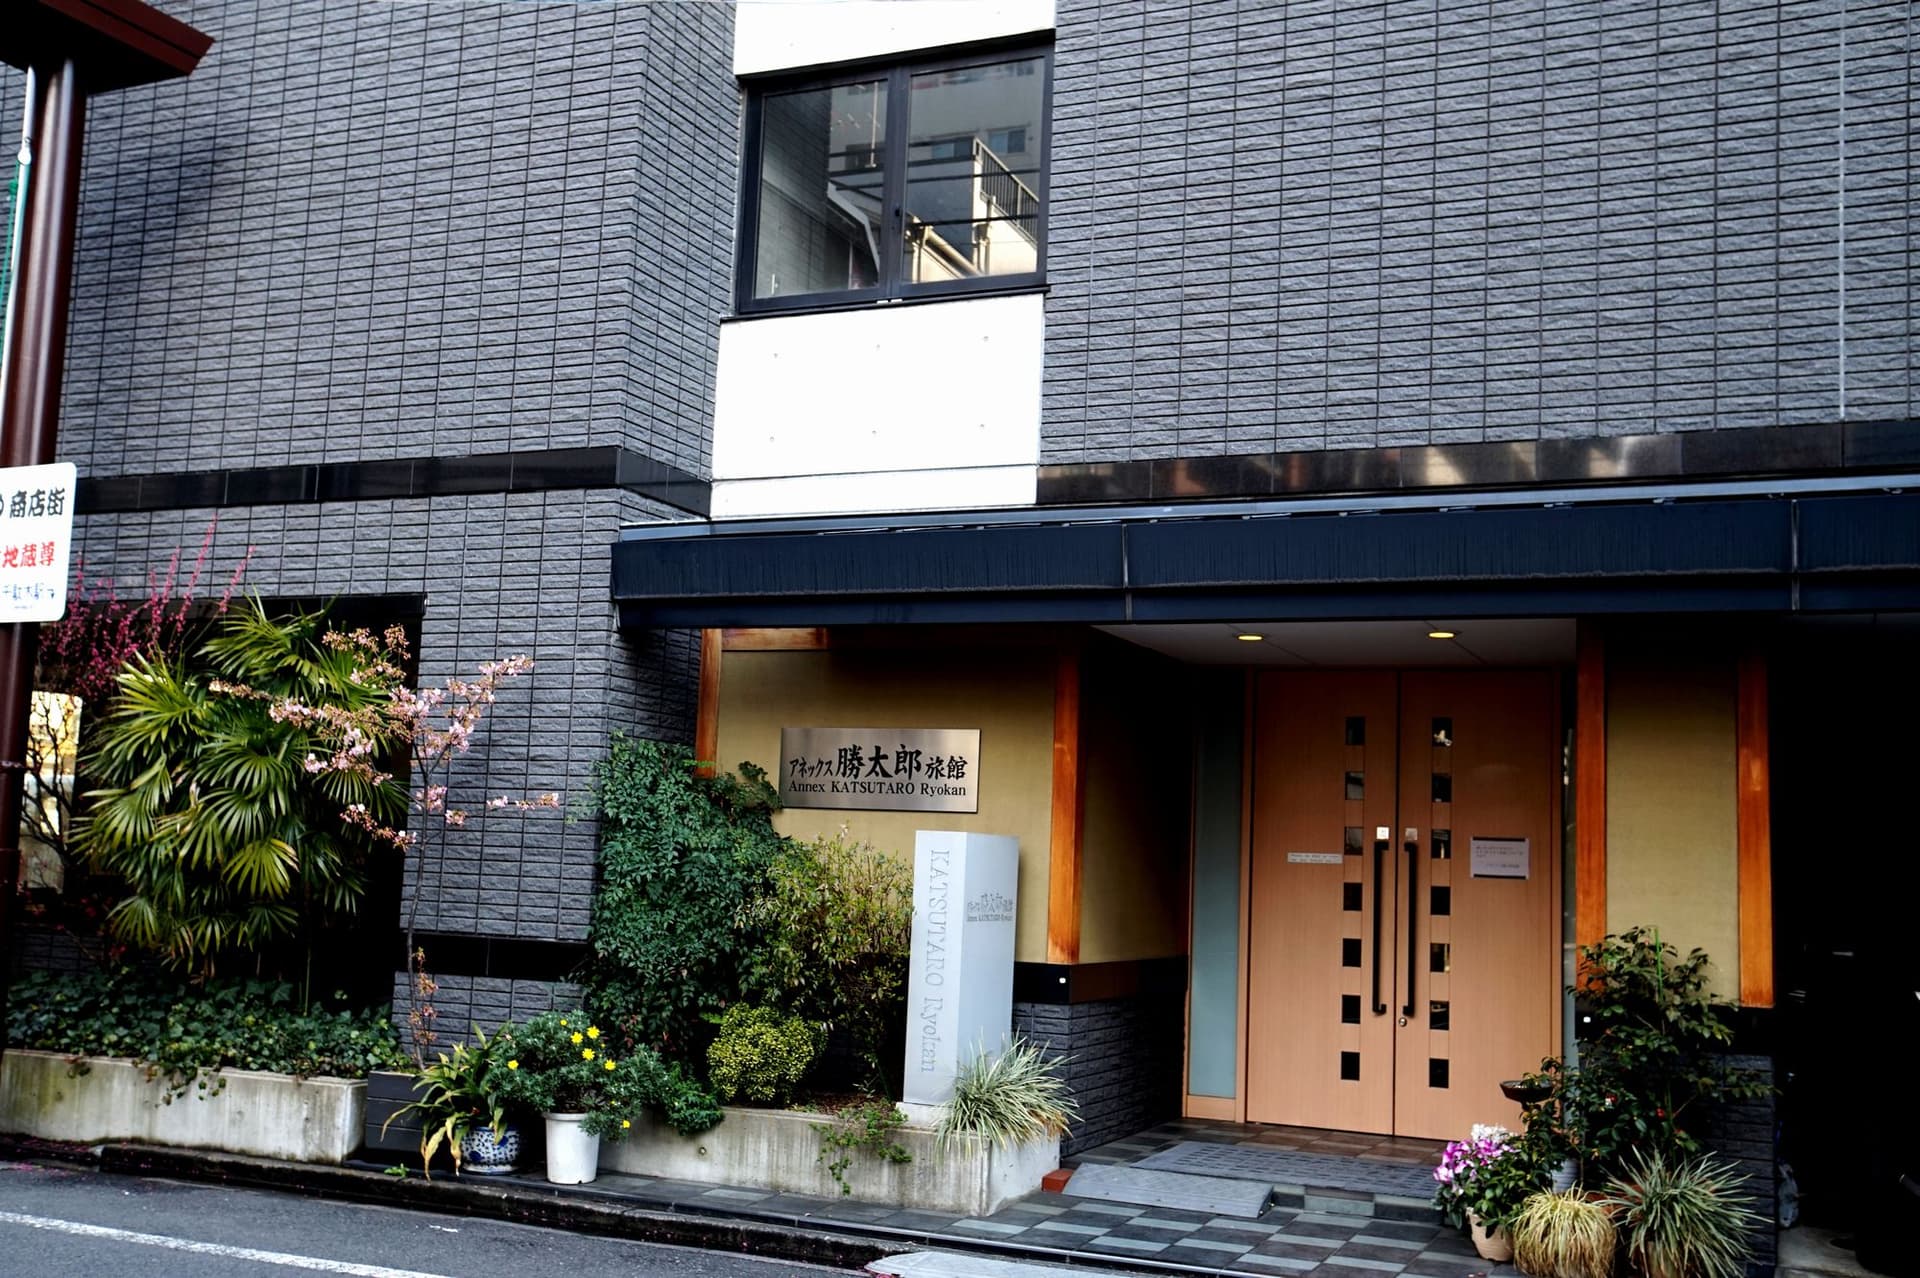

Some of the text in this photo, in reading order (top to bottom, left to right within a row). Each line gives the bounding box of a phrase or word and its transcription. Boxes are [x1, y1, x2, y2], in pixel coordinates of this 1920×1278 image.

[789, 744, 968, 780] アネックス勝太郎旅館
[789, 780, 966, 797] Annex KATSUTARO Ryokan
[921, 849, 950, 1074] KATSUTARO Ryokan
